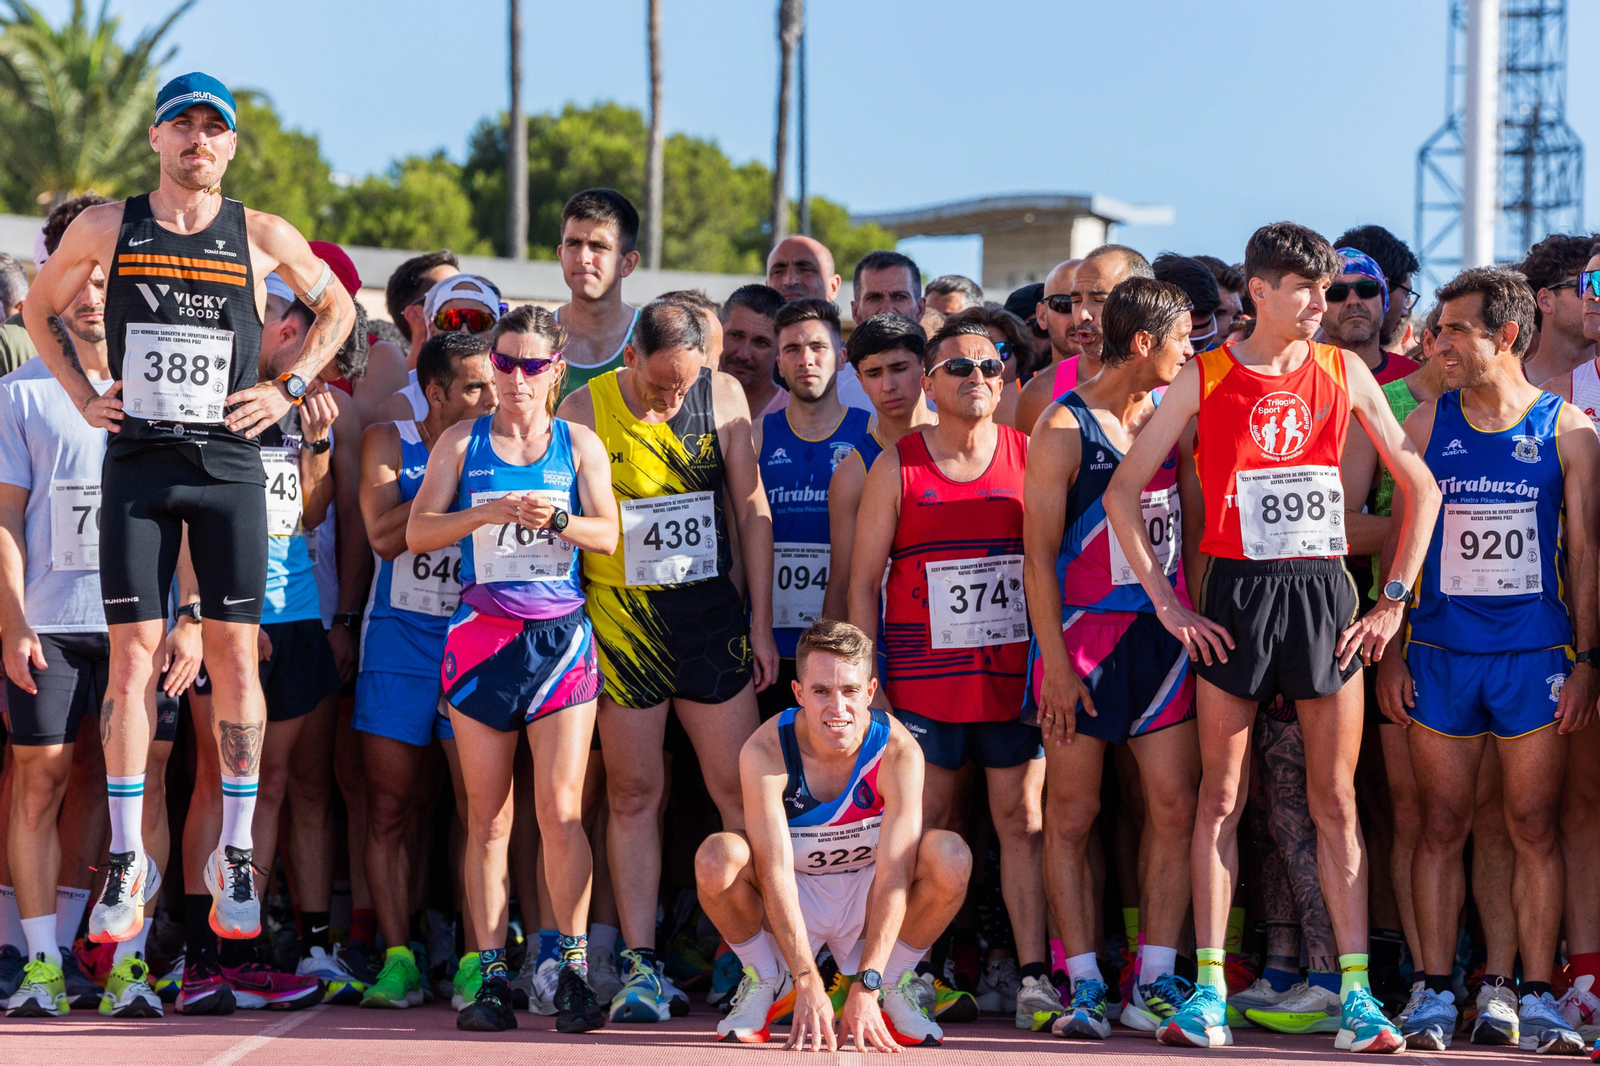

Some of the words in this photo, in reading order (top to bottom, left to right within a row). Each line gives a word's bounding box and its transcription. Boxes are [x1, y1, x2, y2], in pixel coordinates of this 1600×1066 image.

[193, 91, 211, 99] RUN
[174, 292, 227, 309] VICKY
[179, 307, 220, 320] FOODS
[144, 351, 209, 386] 388
[1258, 406, 1280, 415] Sport
[1266, 398, 1296, 407] Trilogie
[266, 472, 297, 501] 43
[1438, 476, 1540, 499] Tirabuzón
[1262, 491, 1326, 524] 898
[644, 518, 701, 551] 438
[1144, 512, 1174, 546] 05
[1460, 530, 1523, 560] 920
[778, 565, 828, 590] 094
[950, 580, 1009, 614] 374
[808, 846, 872, 868] 322
